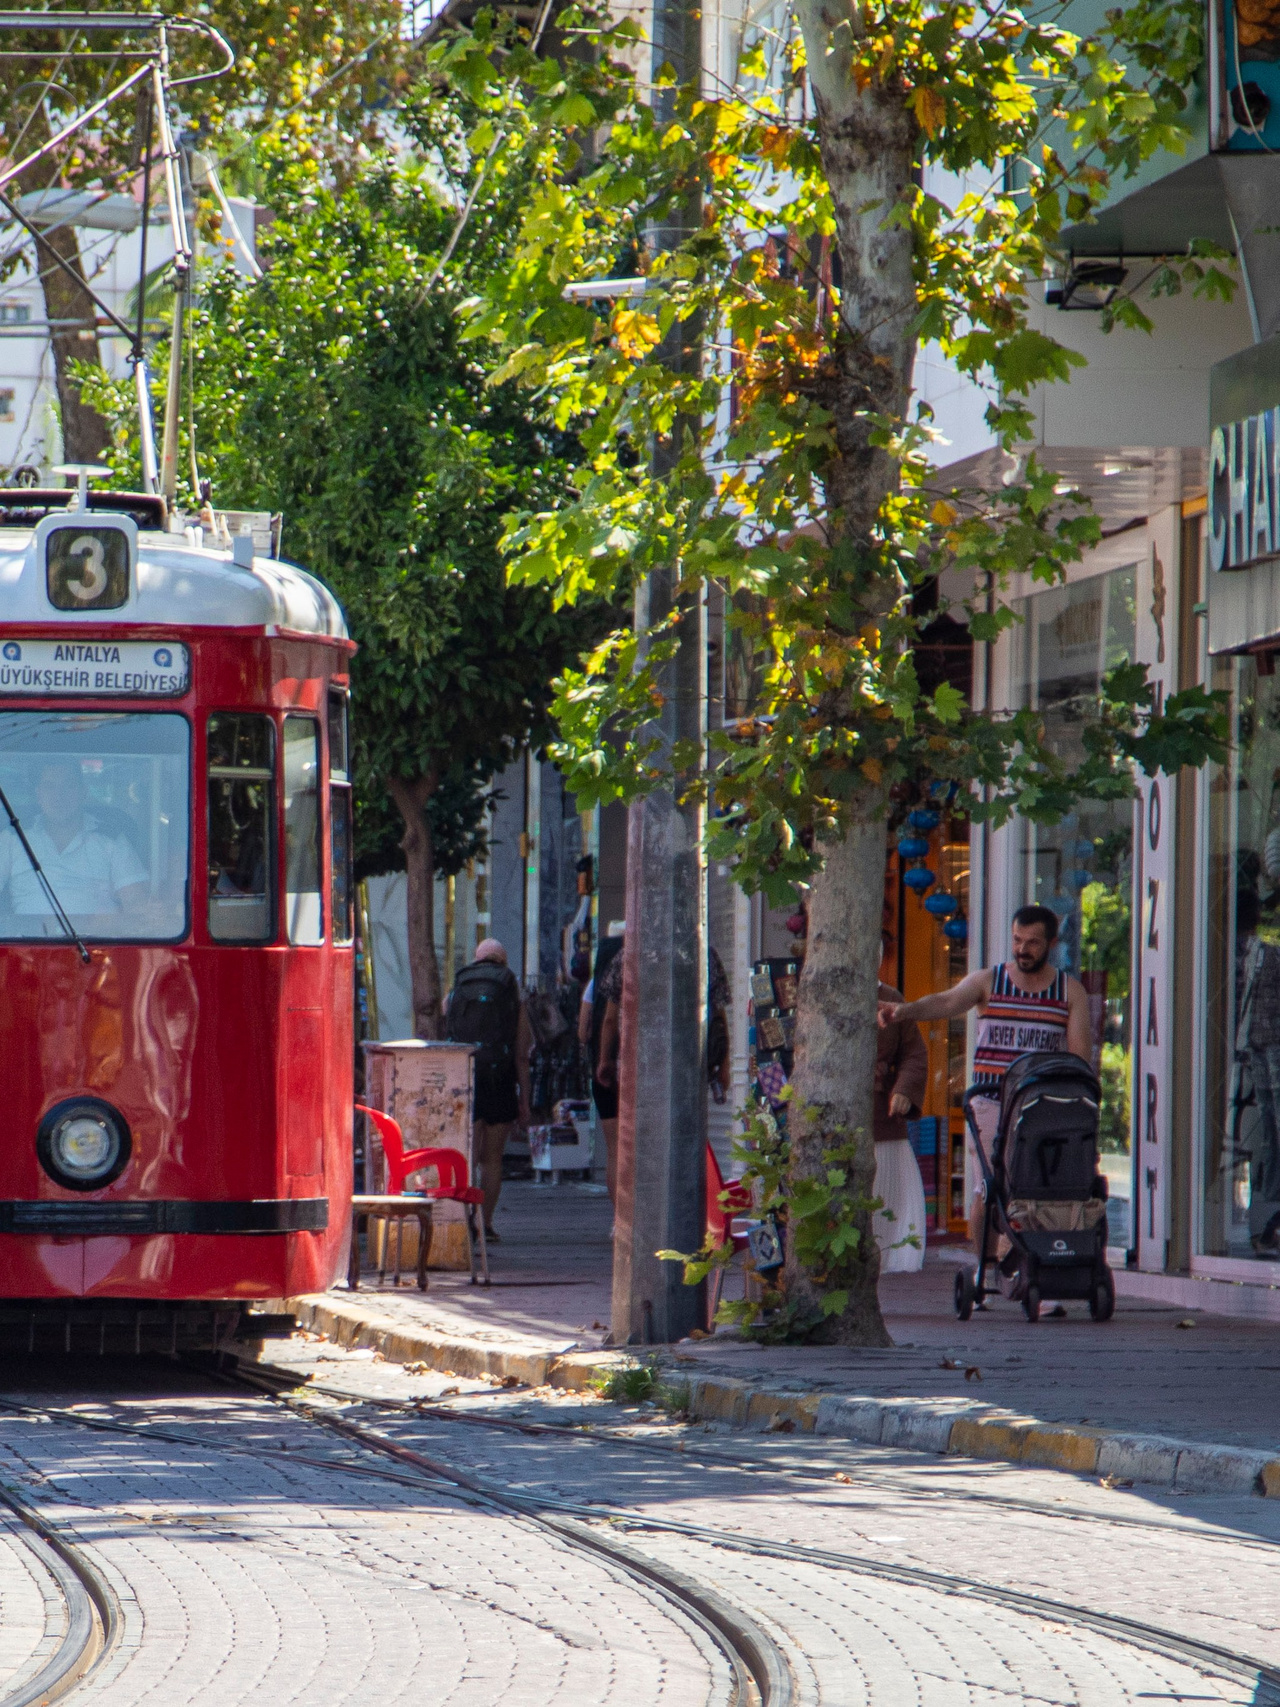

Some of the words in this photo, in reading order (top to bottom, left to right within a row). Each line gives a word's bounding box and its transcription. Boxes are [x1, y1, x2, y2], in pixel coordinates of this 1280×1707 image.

[1208, 405, 1280, 571] CHA
[67, 535, 107, 600] 3
[54, 644, 121, 663] ANTALYA
[989, 1025, 1015, 1046] NEVER
